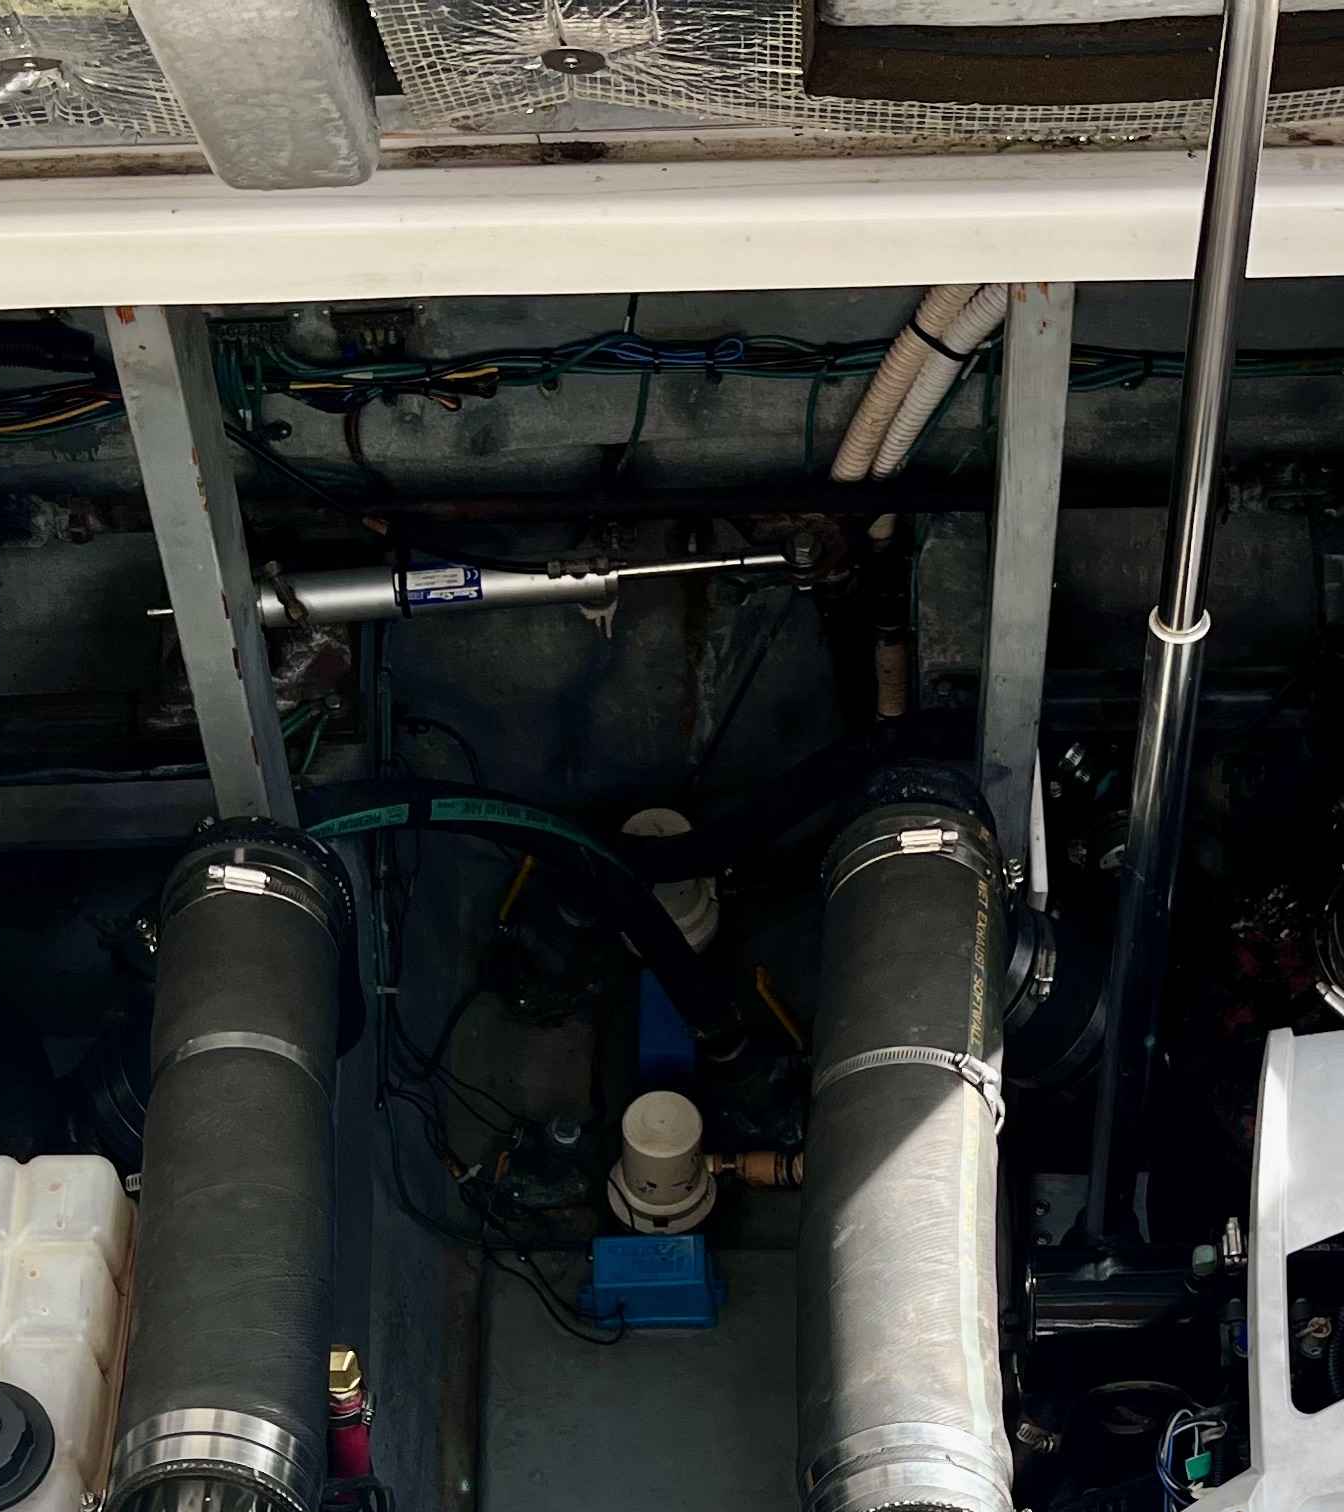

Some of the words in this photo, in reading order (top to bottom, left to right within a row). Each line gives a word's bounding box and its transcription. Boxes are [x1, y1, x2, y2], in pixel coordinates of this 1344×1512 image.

[977, 879, 990, 910] WET
[974, 911, 988, 970] EXHAUST
[970, 974, 984, 1047] SOFTWALL
